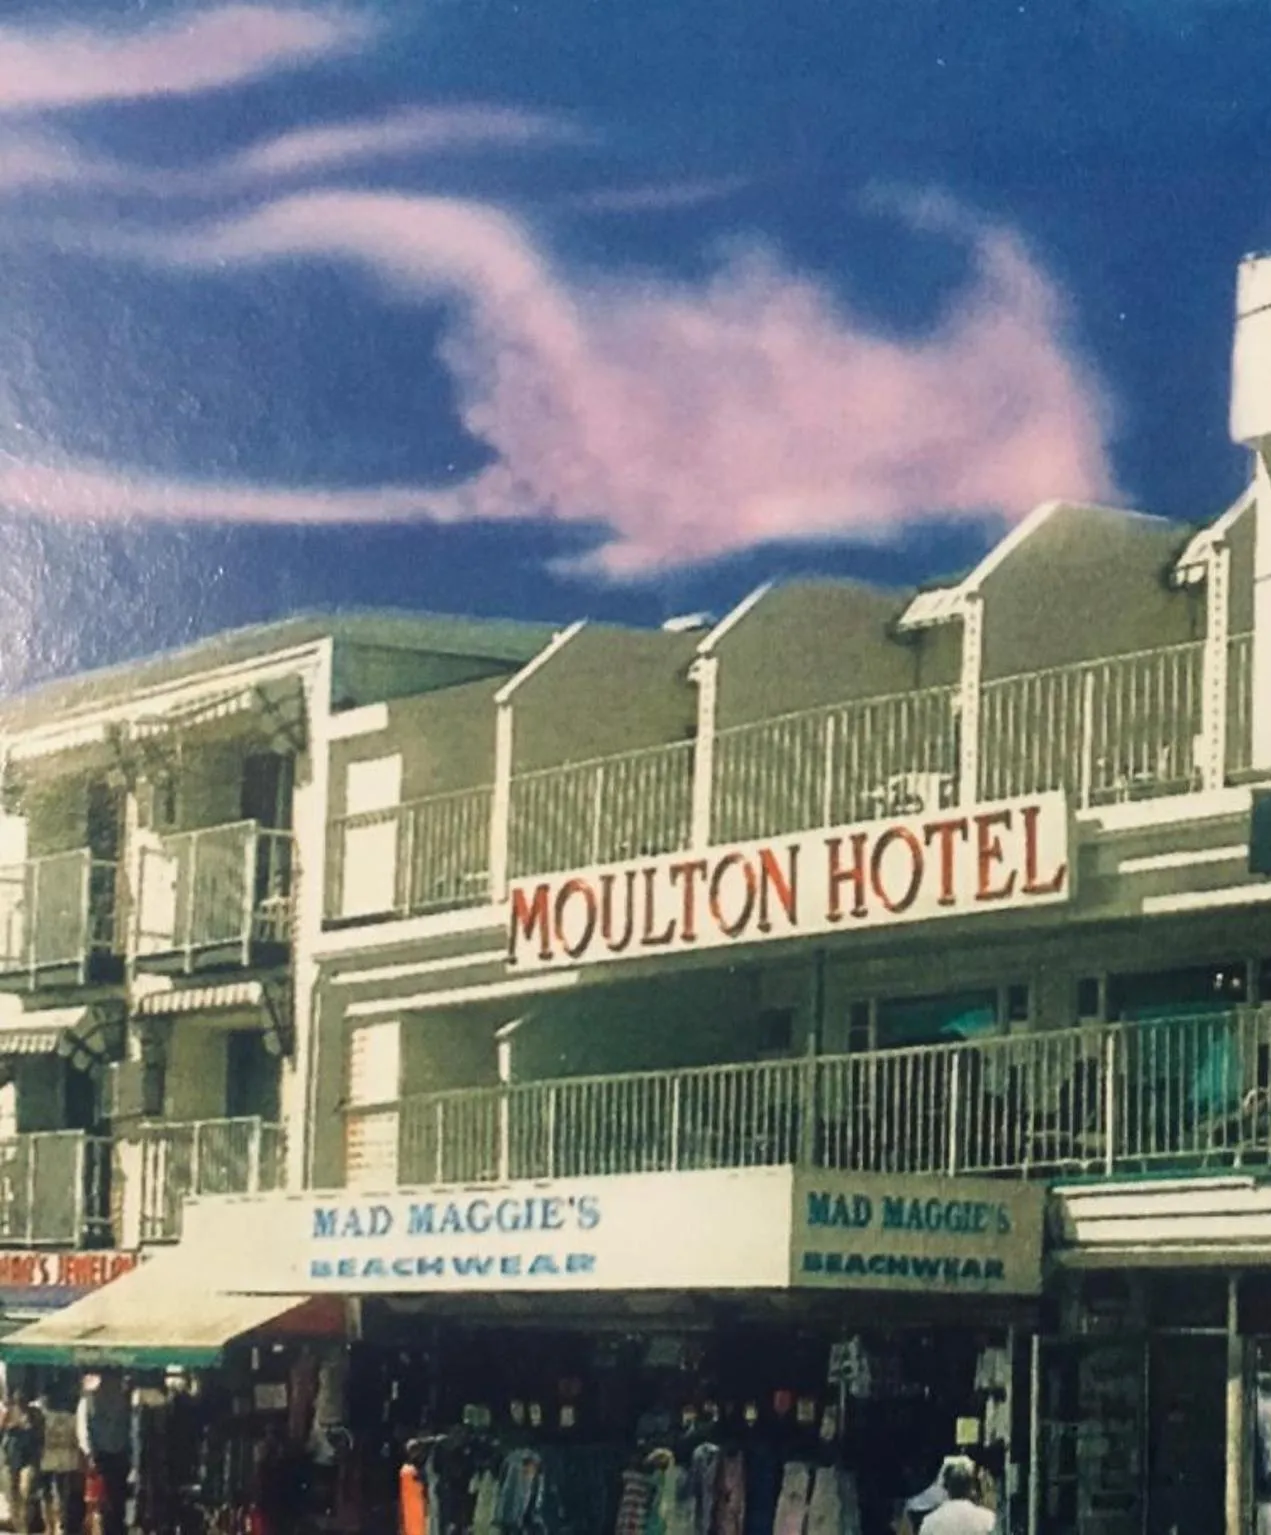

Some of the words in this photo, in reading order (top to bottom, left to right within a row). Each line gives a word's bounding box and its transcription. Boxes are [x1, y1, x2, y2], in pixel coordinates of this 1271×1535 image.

[508, 844, 801, 966] MOULTON
[823, 806, 1067, 922] HOTEL
[312, 1204, 394, 1239] MAD
[406, 1194, 602, 1236] MAGGIE'S
[806, 1191, 873, 1229] MAD
[881, 1195, 1012, 1235] MAGGIE'S
[309, 1252, 598, 1279] BEACHWEAR
[801, 1252, 1006, 1282] BEACHWEAR
